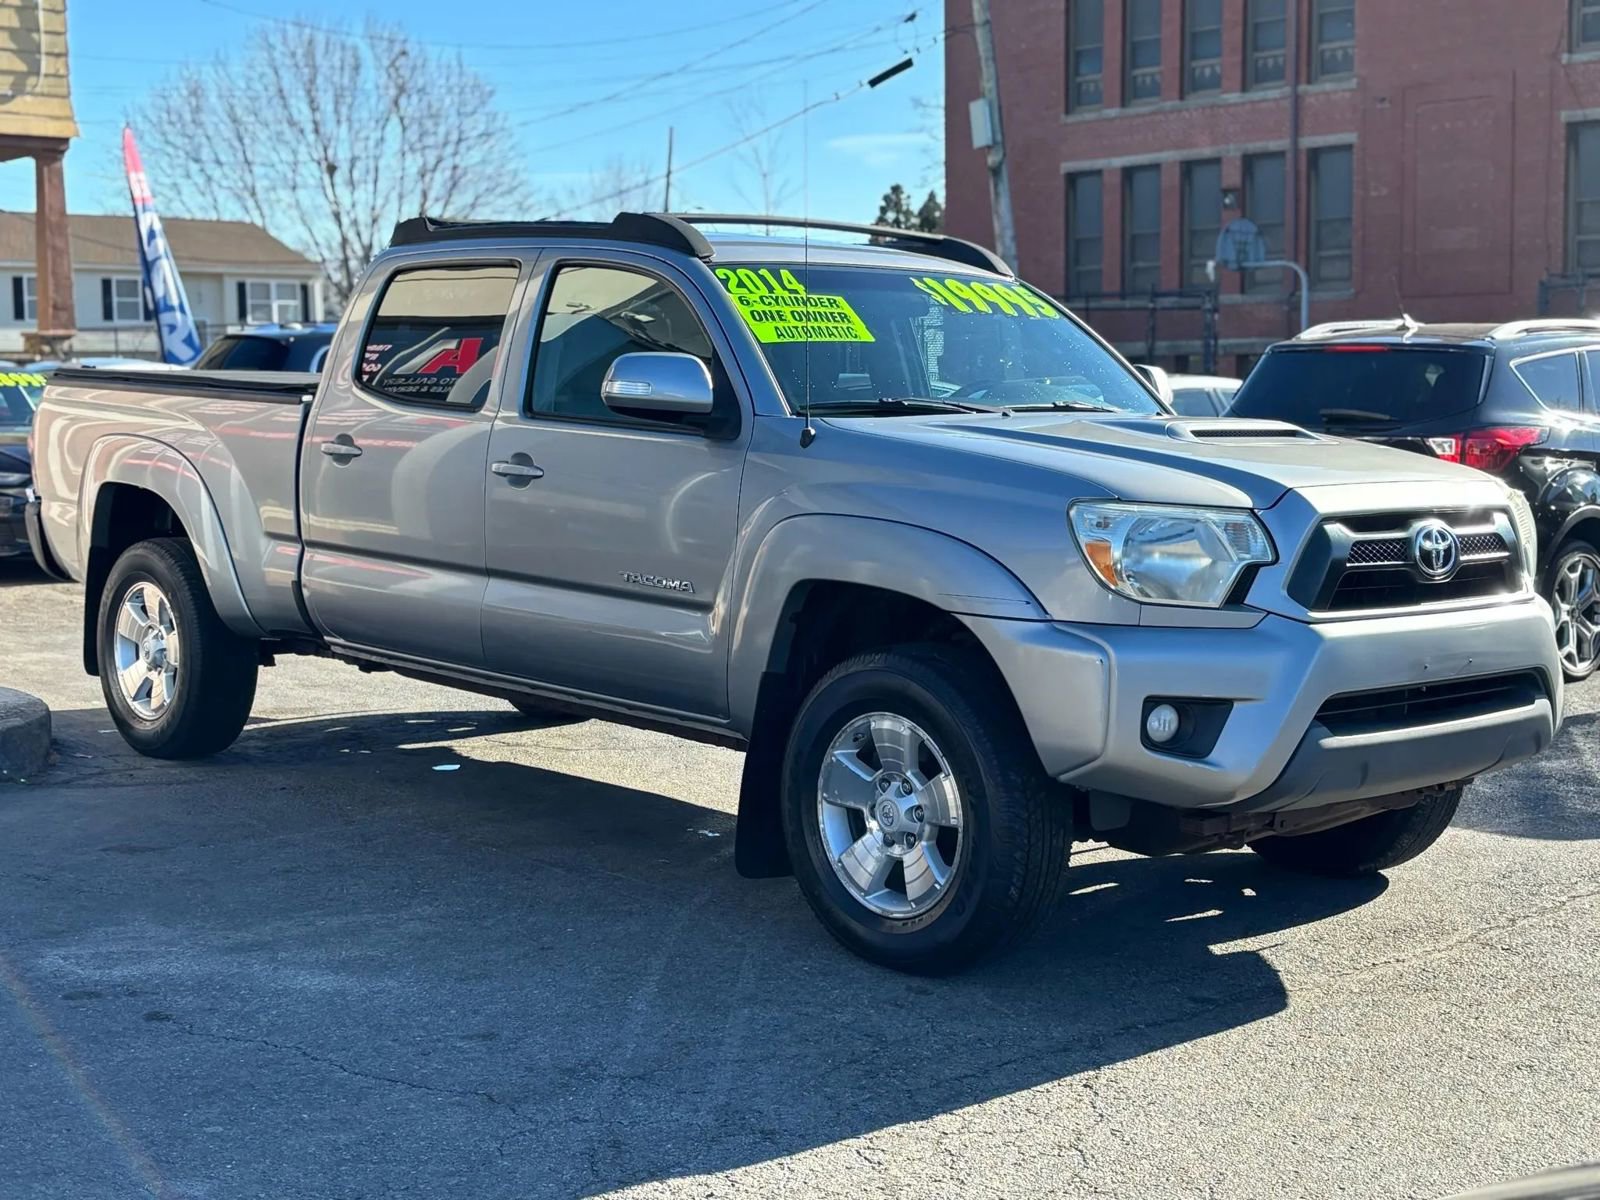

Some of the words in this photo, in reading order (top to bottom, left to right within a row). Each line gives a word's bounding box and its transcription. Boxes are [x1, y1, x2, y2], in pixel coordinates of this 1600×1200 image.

[715, 268, 806, 295] 2014
[737, 295, 841, 309] 6-CYLINDER
[909, 277, 1060, 319] $19995
[750, 310, 788, 323] ONE
[789, 310, 851, 324] OWNER
[775, 325, 859, 340] AUTOMATIC
[617, 571, 696, 593] TACOMA
